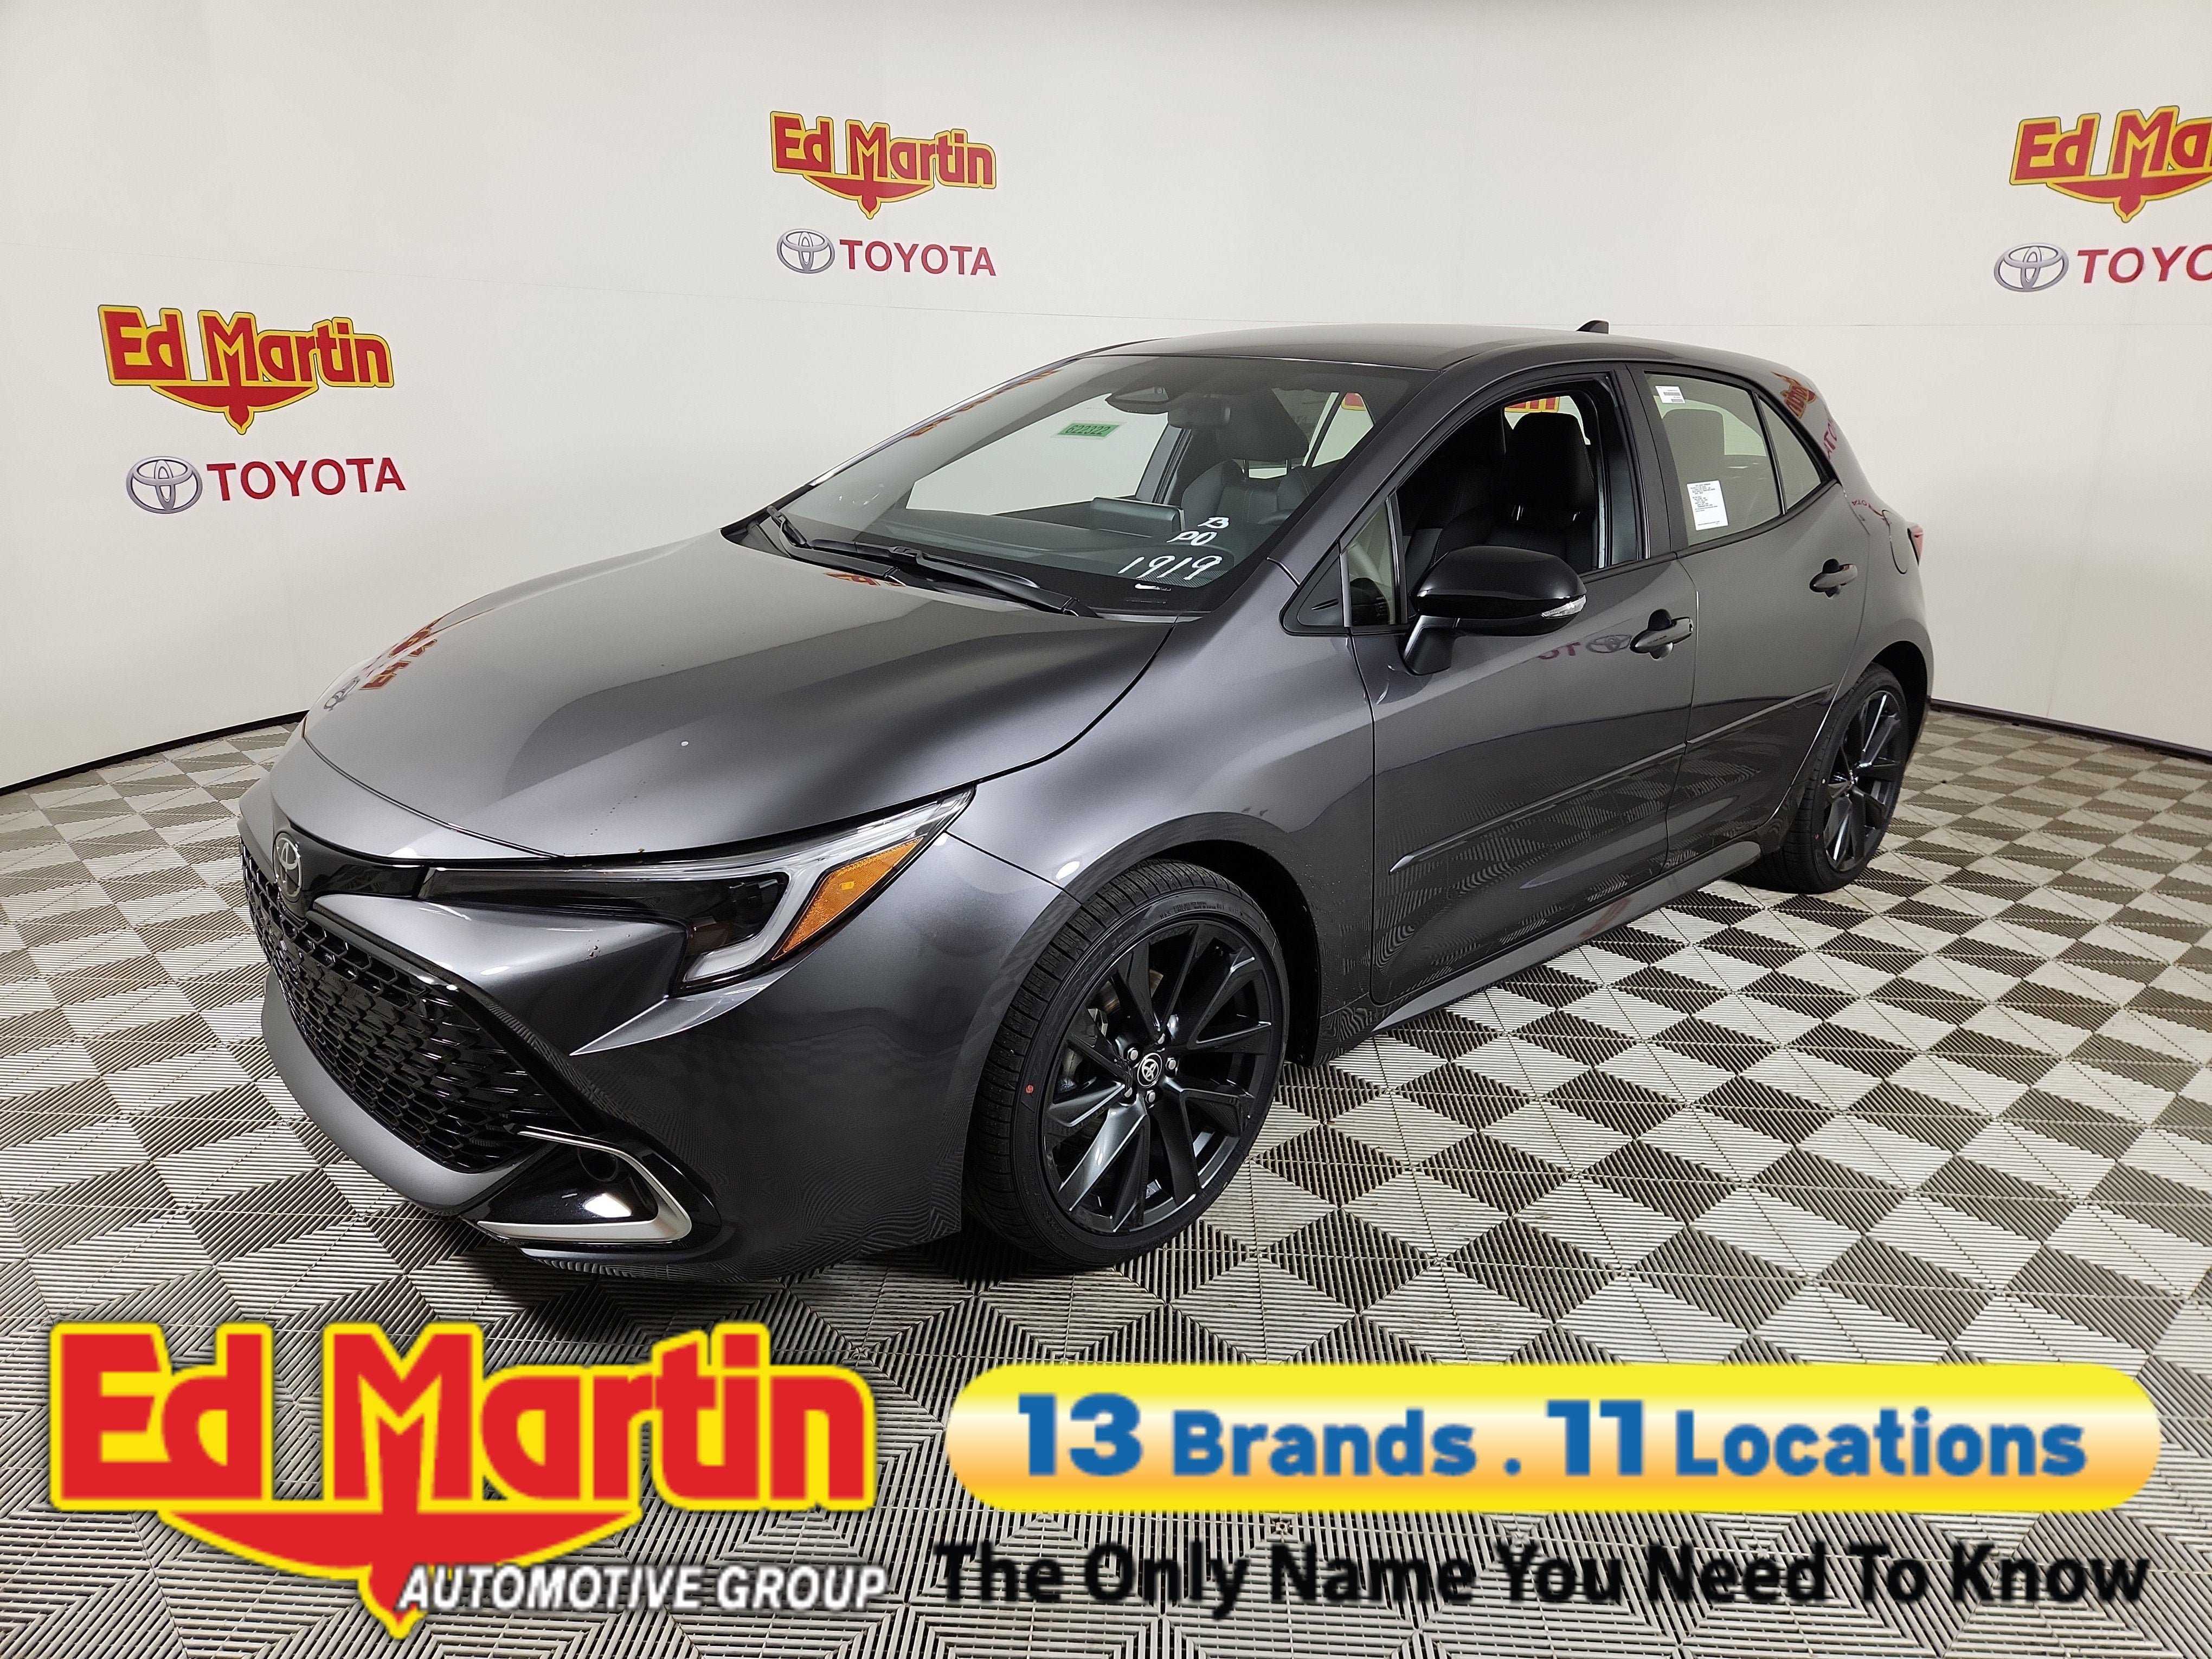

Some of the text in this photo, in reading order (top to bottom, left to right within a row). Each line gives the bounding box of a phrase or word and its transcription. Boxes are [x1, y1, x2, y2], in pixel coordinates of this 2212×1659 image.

[770, 111, 996, 189] Ed Martin
[2010, 106, 2212, 185] Ed Ma
[839, 239, 996, 276] TOYOTA
[98, 305, 394, 388] Ed Martin
[207, 458, 406, 501] TOYOTA
[1117, 555, 1223, 580] 1919
